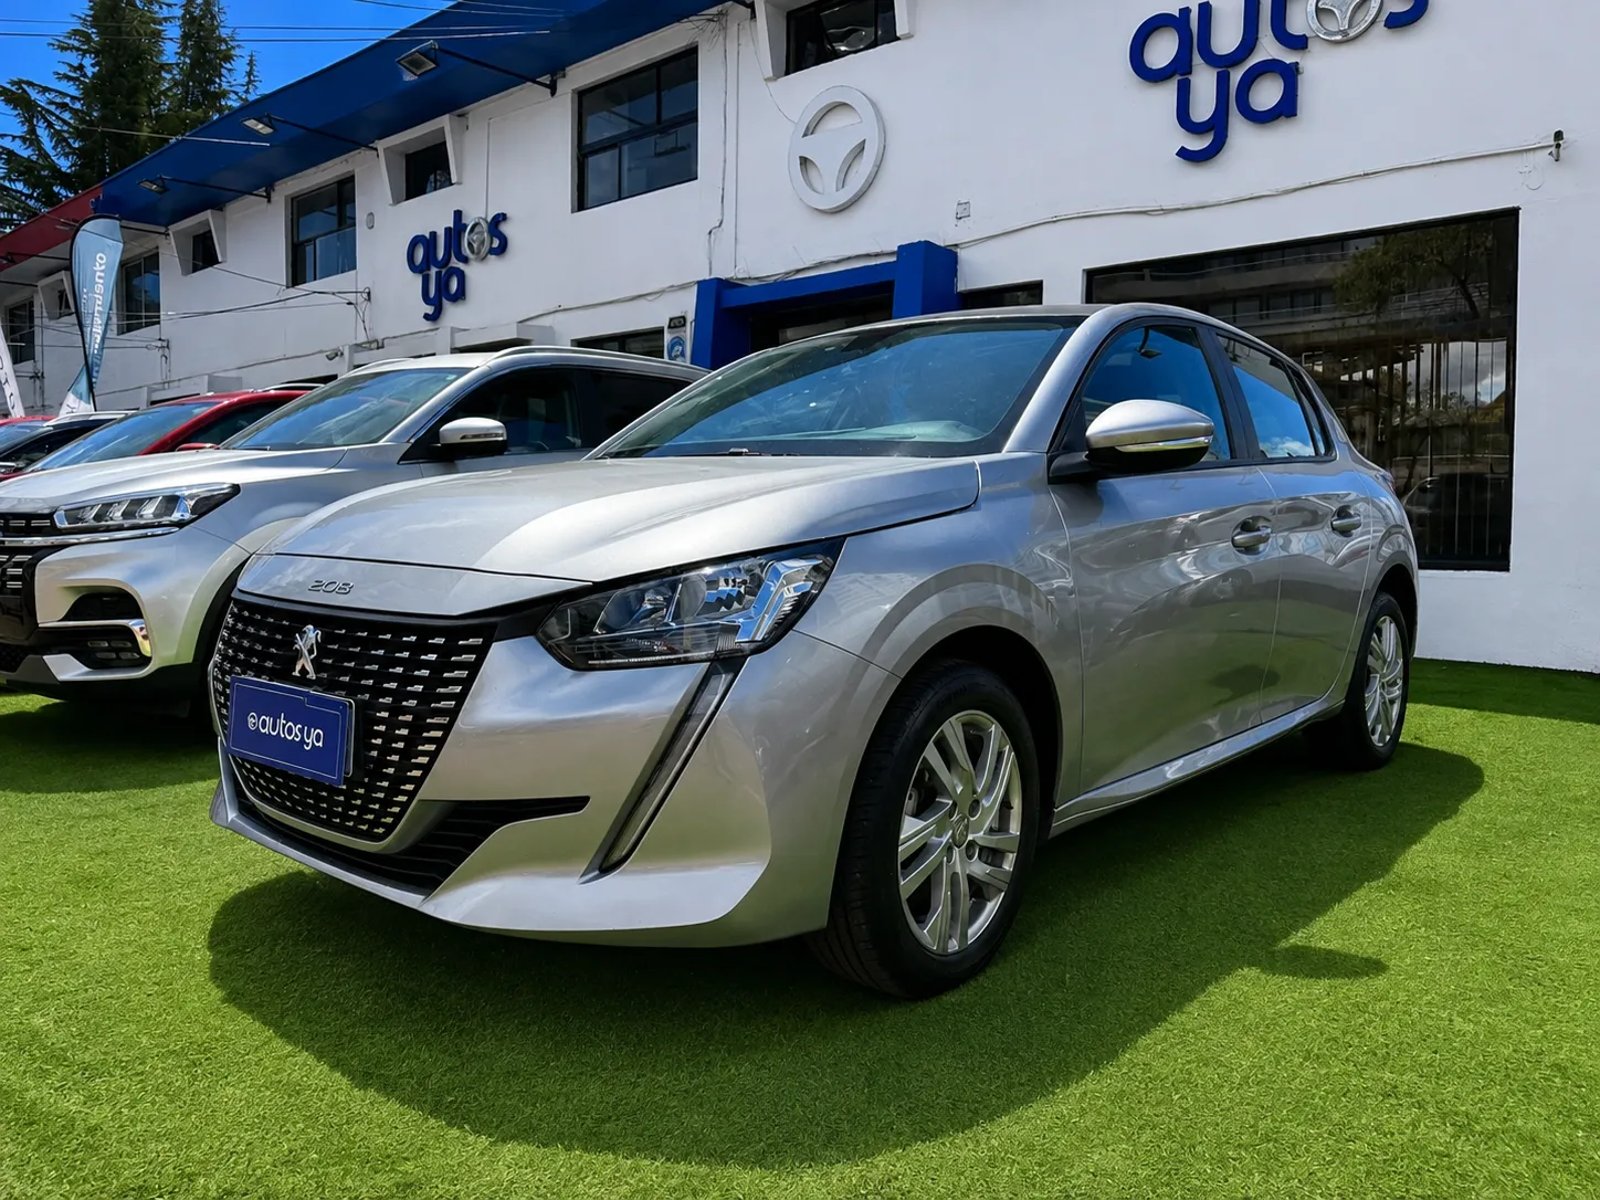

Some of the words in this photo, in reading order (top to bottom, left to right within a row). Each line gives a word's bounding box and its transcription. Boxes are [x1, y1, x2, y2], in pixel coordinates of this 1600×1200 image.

[1175, 58, 1299, 163] ya
[406, 209, 508, 274] autos
[421, 266, 466, 322] ya
[308, 579, 354, 595] 208
